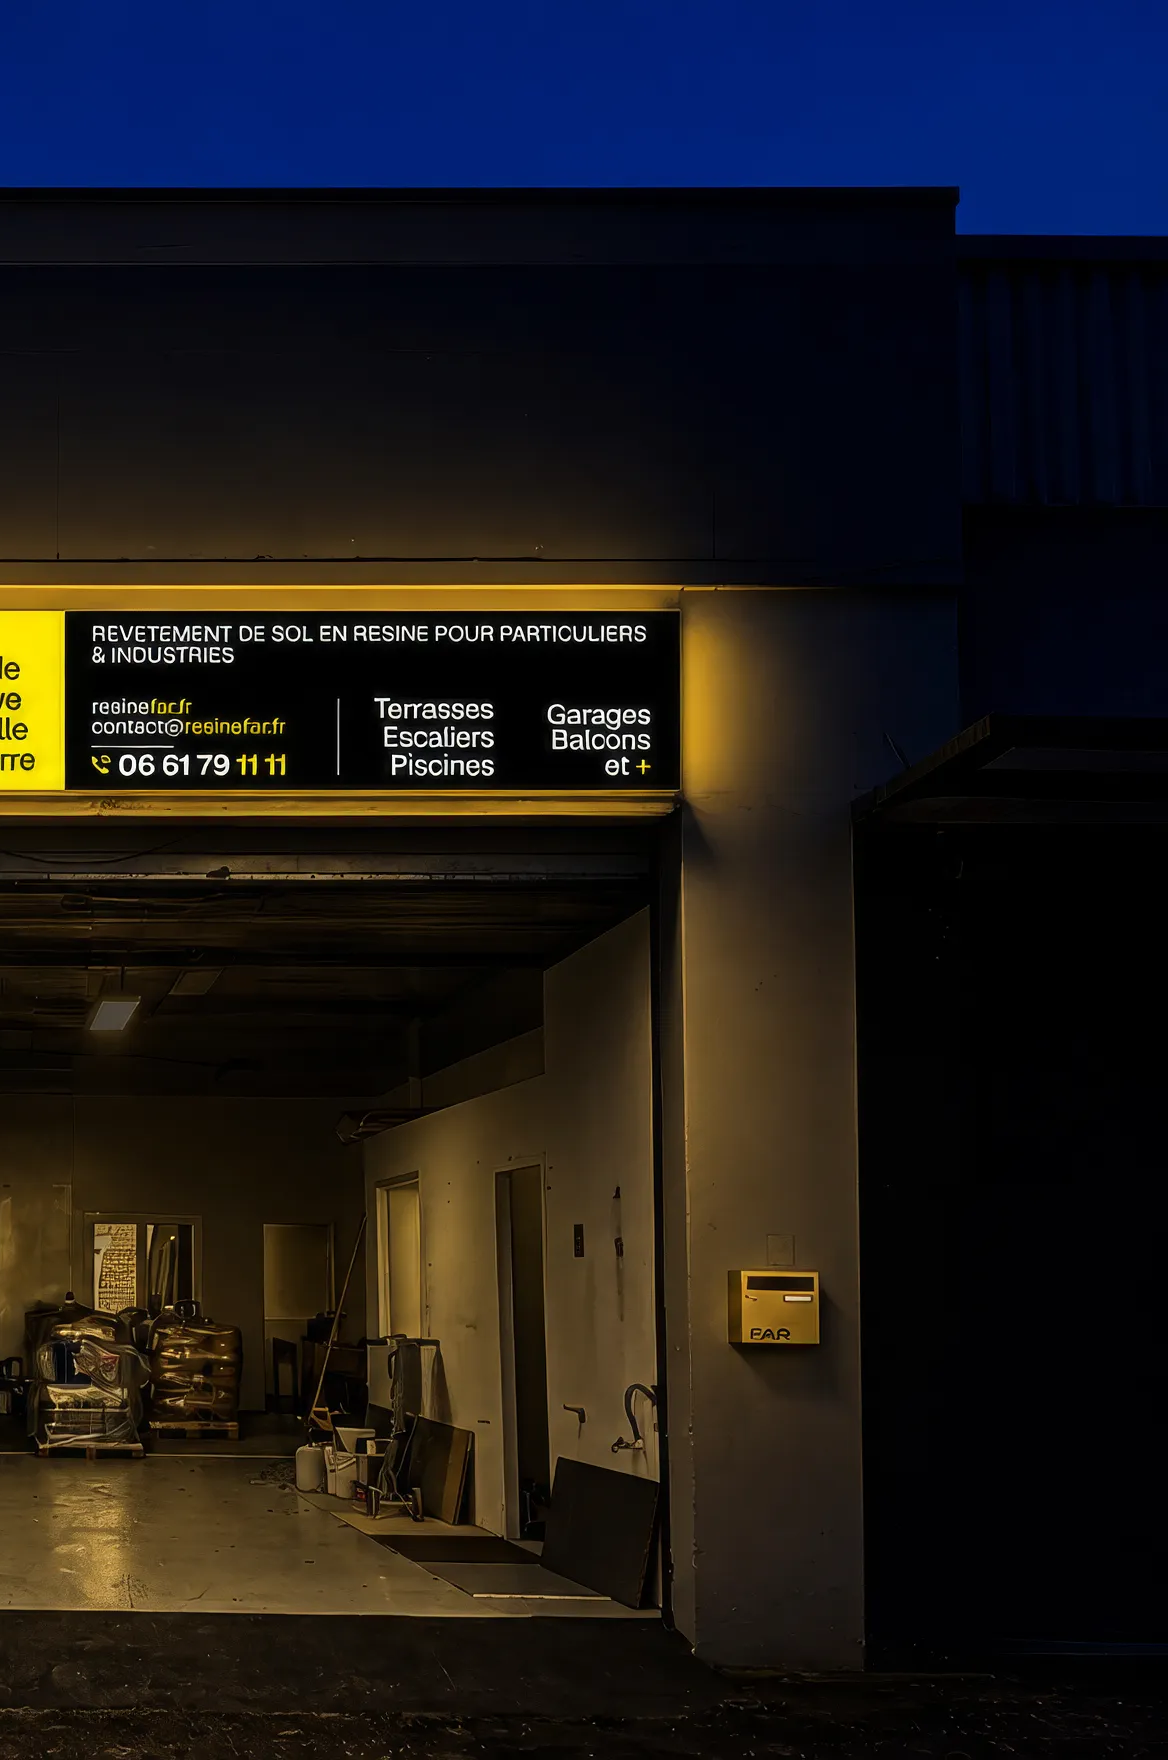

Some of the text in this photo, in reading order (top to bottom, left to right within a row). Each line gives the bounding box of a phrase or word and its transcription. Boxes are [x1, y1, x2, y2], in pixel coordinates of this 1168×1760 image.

[93, 625, 646, 642] REVETEMENT DE SOL EN RESINE POUR PARTICULIERS
[92, 646, 234, 663] & INDUSTRIES
[374, 698, 494, 720] Terrasses
[548, 704, 650, 729] Garages
[384, 726, 494, 748] Escaliers
[552, 727, 650, 750] Balcons
[119, 754, 285, 776] 06 61 79 11 11
[392, 753, 494, 776] Piscines
[605, 757, 629, 776] et
[750, 1327, 791, 1341] FAR
